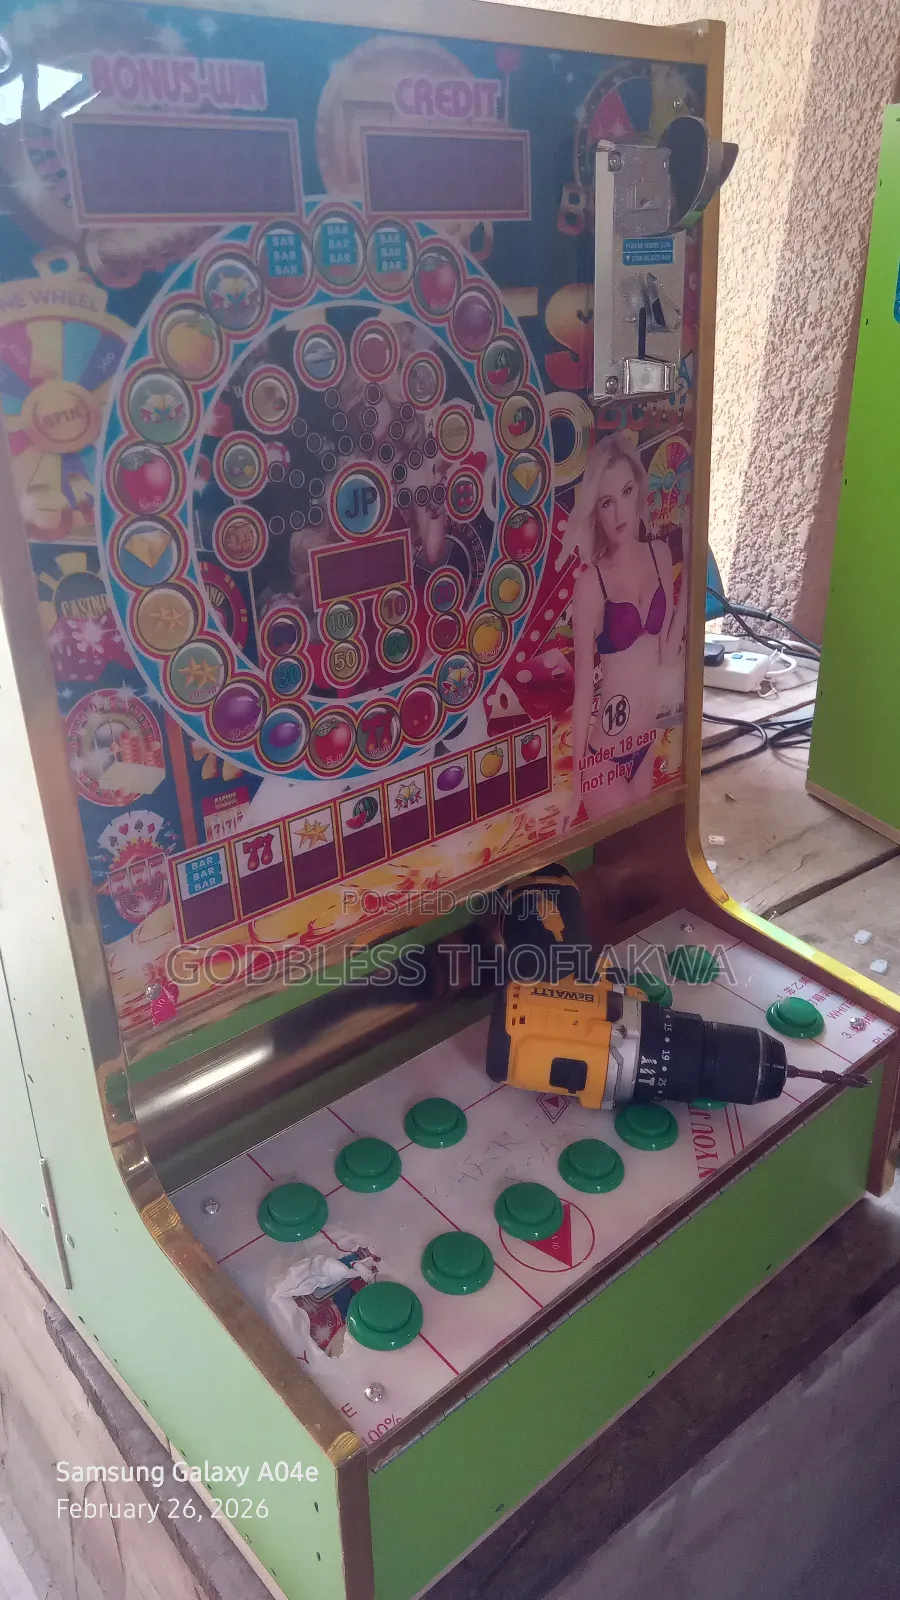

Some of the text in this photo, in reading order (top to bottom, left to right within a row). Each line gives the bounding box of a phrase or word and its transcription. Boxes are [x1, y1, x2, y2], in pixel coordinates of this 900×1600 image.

[91, 54, 266, 109] BONUS-WIN
[394, 78, 501, 118] CREDIT
[327, 225, 349, 236] BAR
[272, 236, 295, 247] BAR
[328, 239, 350, 250] BAR
[380, 233, 400, 244] BAR
[274, 251, 296, 261] BAR
[330, 253, 351, 263] BAR
[381, 247, 400, 257] BAR
[275, 265, 297, 276] BAR
[382, 260, 401, 270] BAR
[344, 486, 377, 519] JP
[383, 595, 405, 618] 10
[329, 610, 355, 632] 100
[334, 649, 356, 671] 50
[605, 699, 627, 730] 18
[578, 729, 657, 771] under 18 can
[582, 761, 633, 794] not play
[191, 856, 213, 870] BAR
[192, 867, 215, 881] BAR
[194, 877, 217, 892] BAR
[661, 1049, 670, 1060] 19
[658, 1077, 667, 1087] 25
[691, 1123, 718, 1161] YOU
